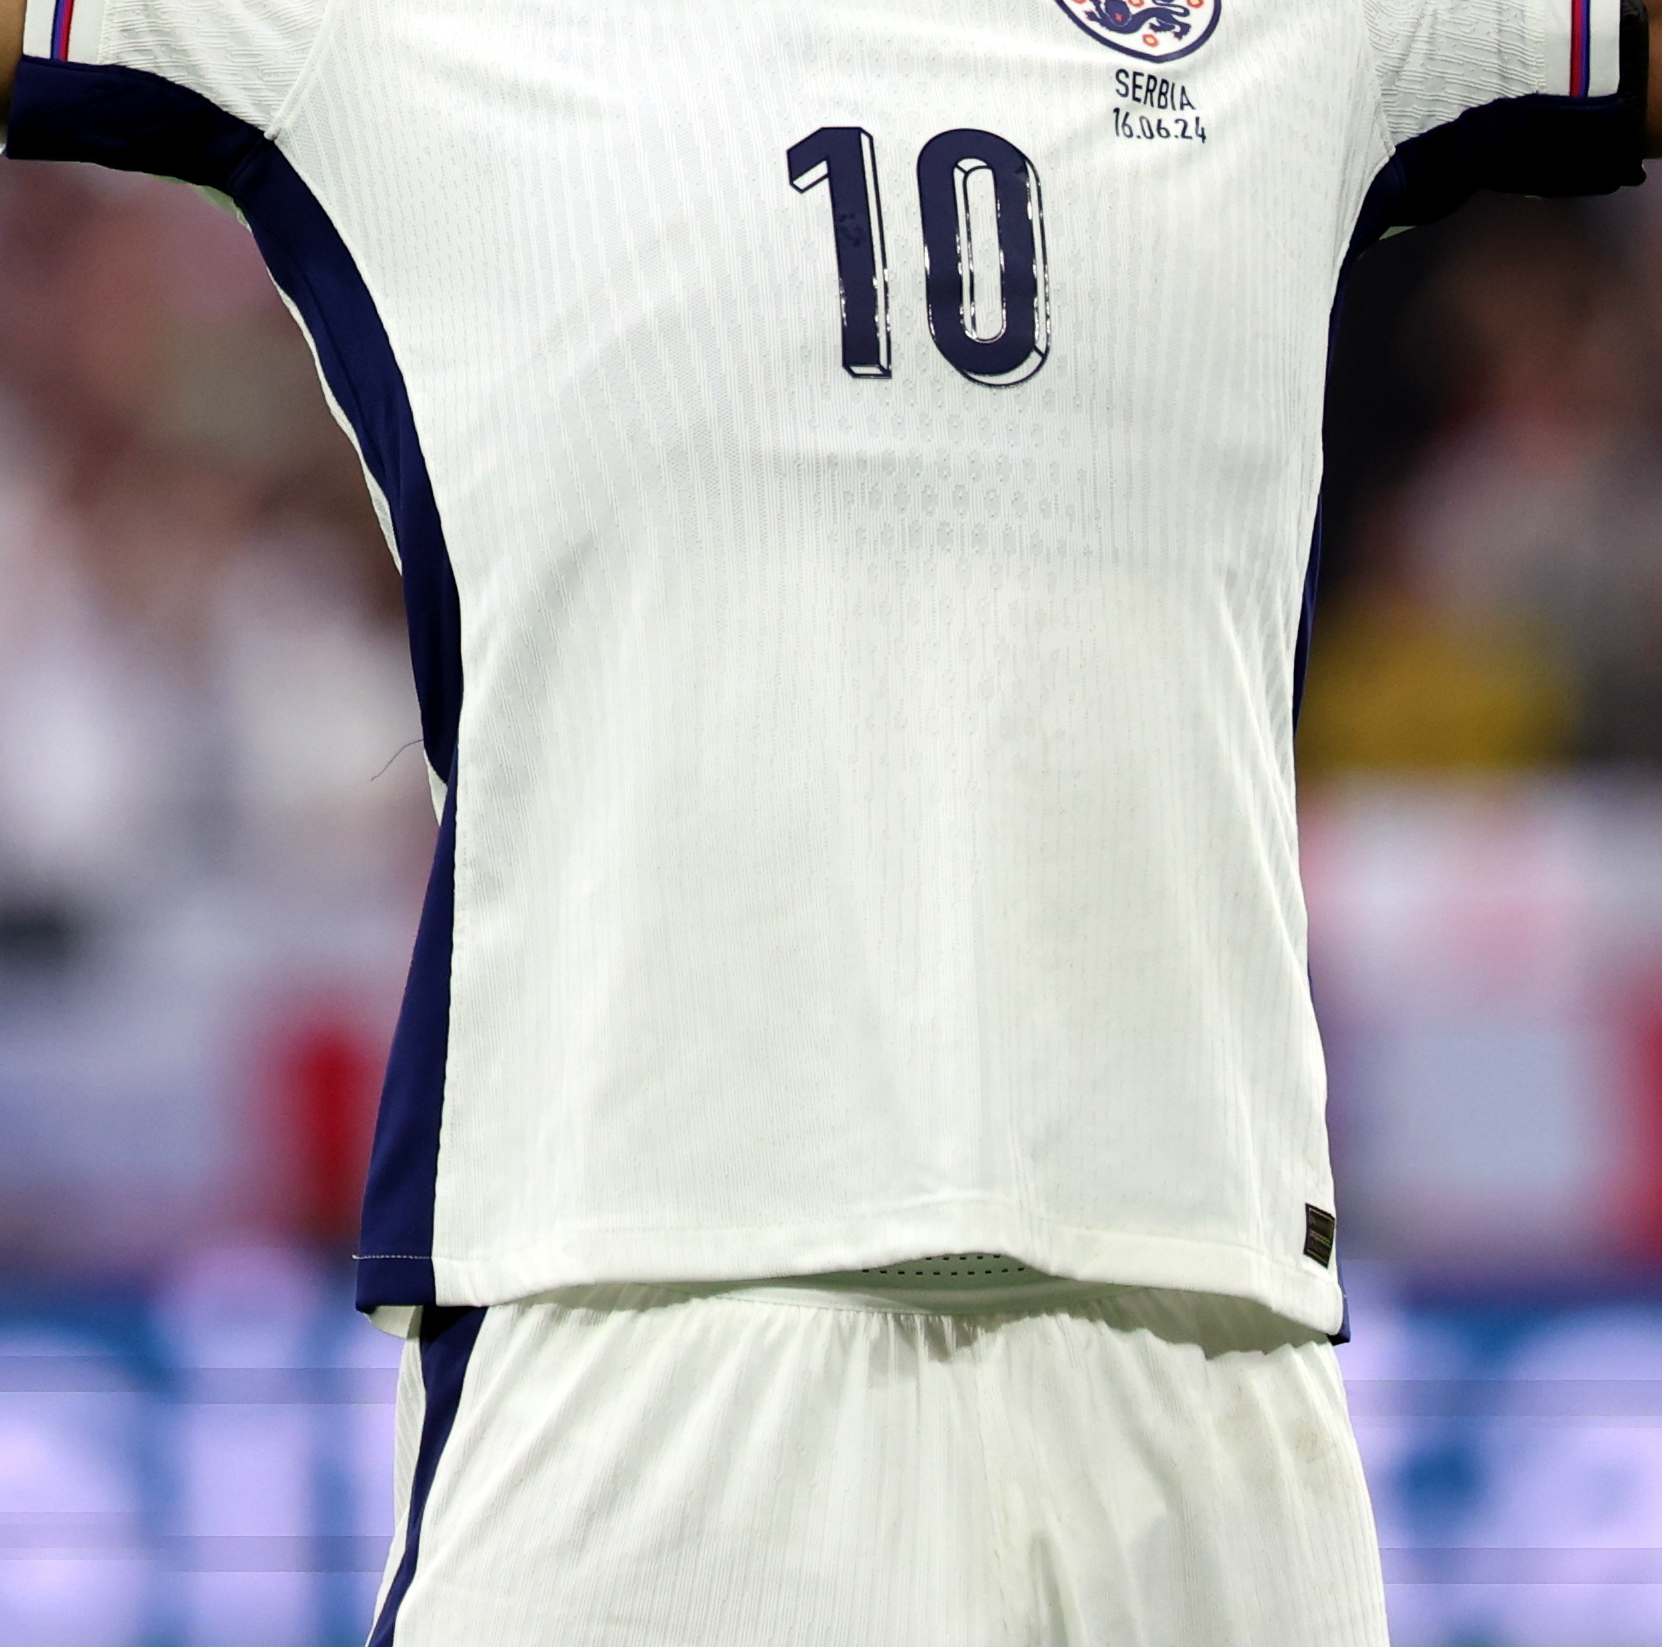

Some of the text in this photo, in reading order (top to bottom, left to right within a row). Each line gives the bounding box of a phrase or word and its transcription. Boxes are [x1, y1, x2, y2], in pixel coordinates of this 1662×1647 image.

[1115, 68, 1196, 111] SERBIA
[1113, 107, 1206, 143] 16.06.24
[786, 126, 1051, 388] 10
